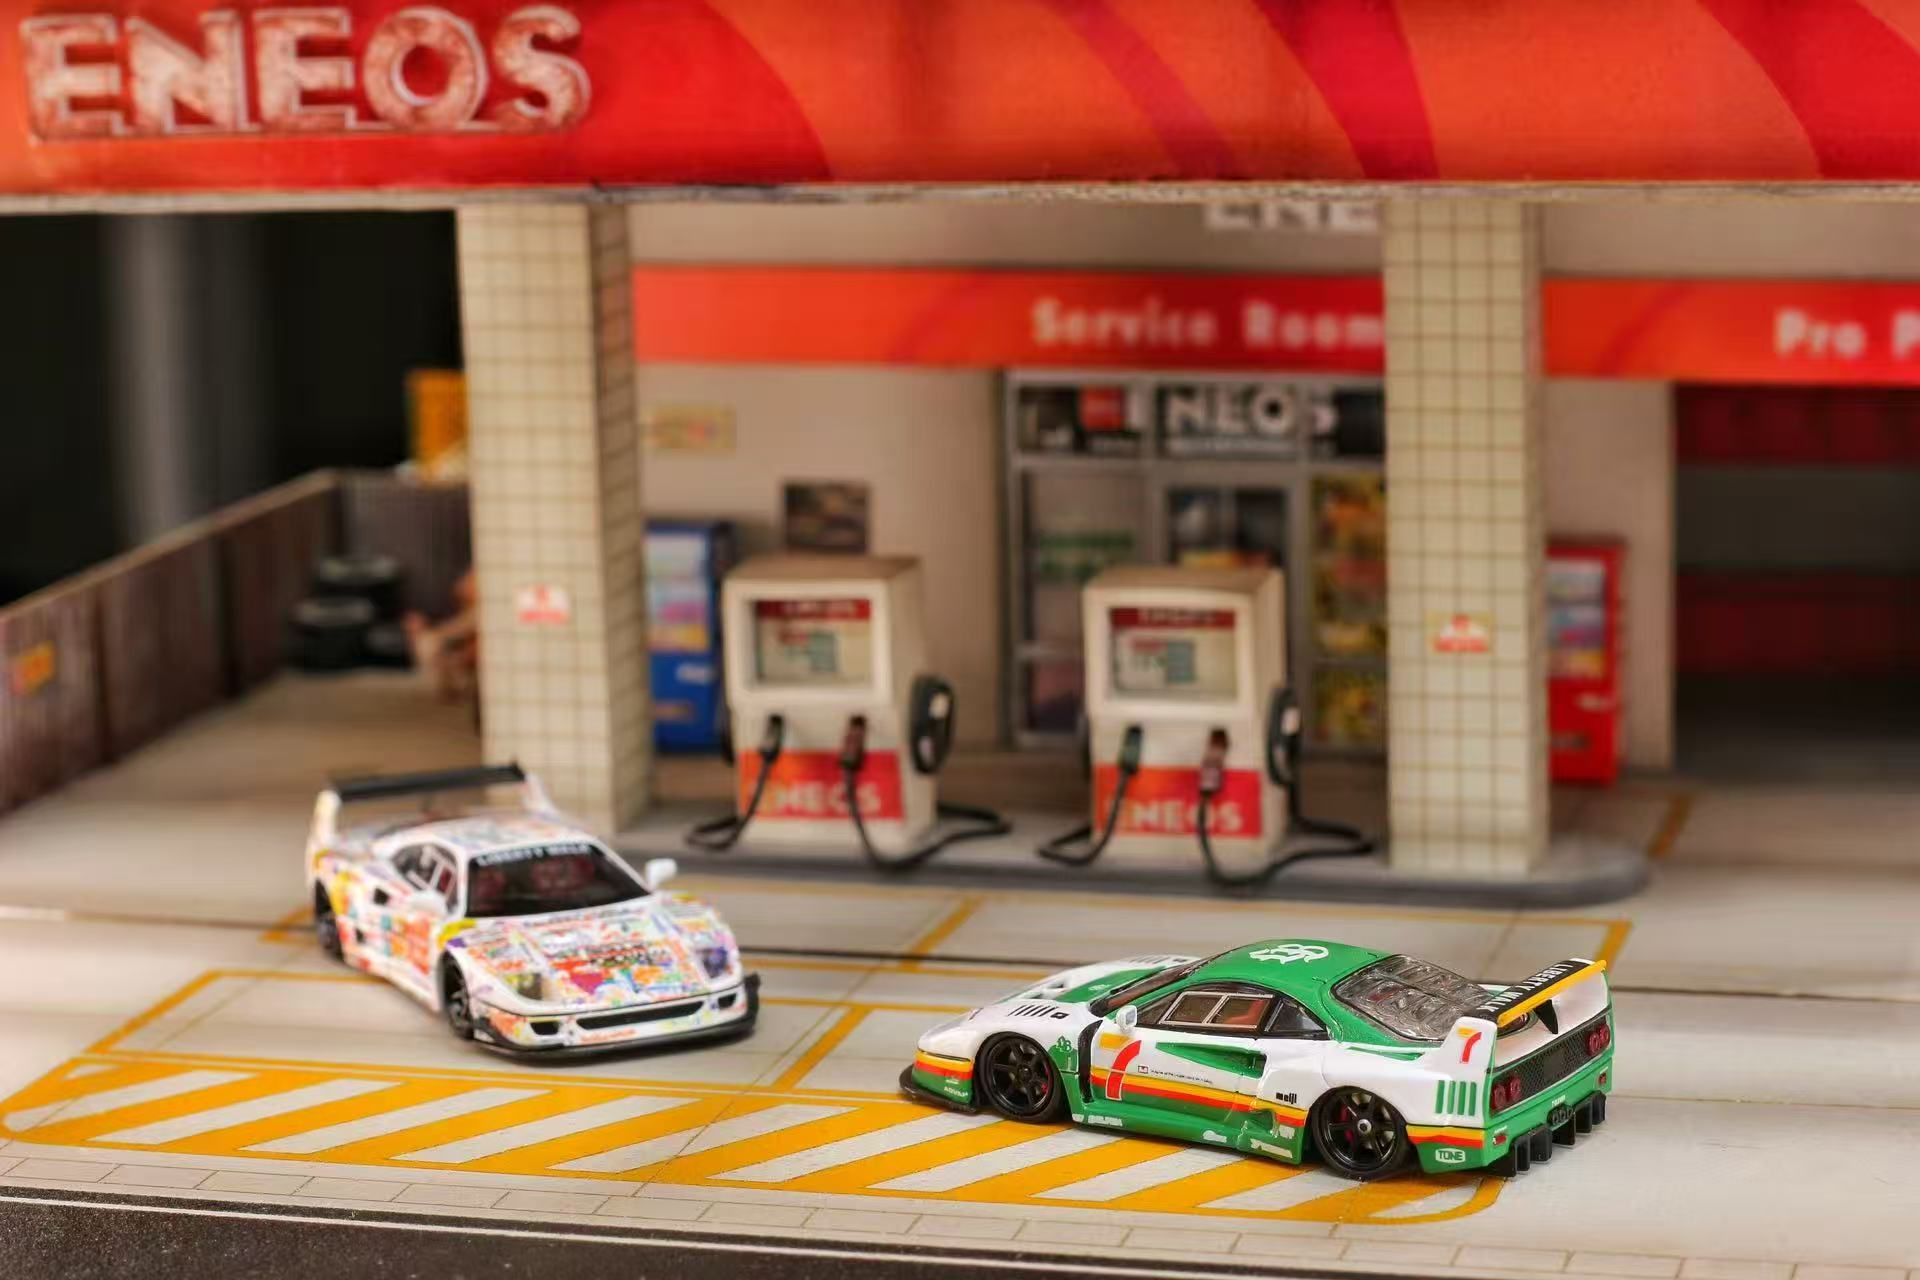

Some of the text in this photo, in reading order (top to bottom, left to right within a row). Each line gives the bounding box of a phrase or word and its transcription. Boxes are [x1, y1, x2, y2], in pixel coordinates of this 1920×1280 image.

[19, 5, 592, 141] ENEOS
[1034, 298, 1384, 347] Service Room
[1774, 309, 1868, 358] Pro
[1476, 963, 1573, 1013] LIBERTY WALK
[1437, 1150, 1464, 1162] TONE
